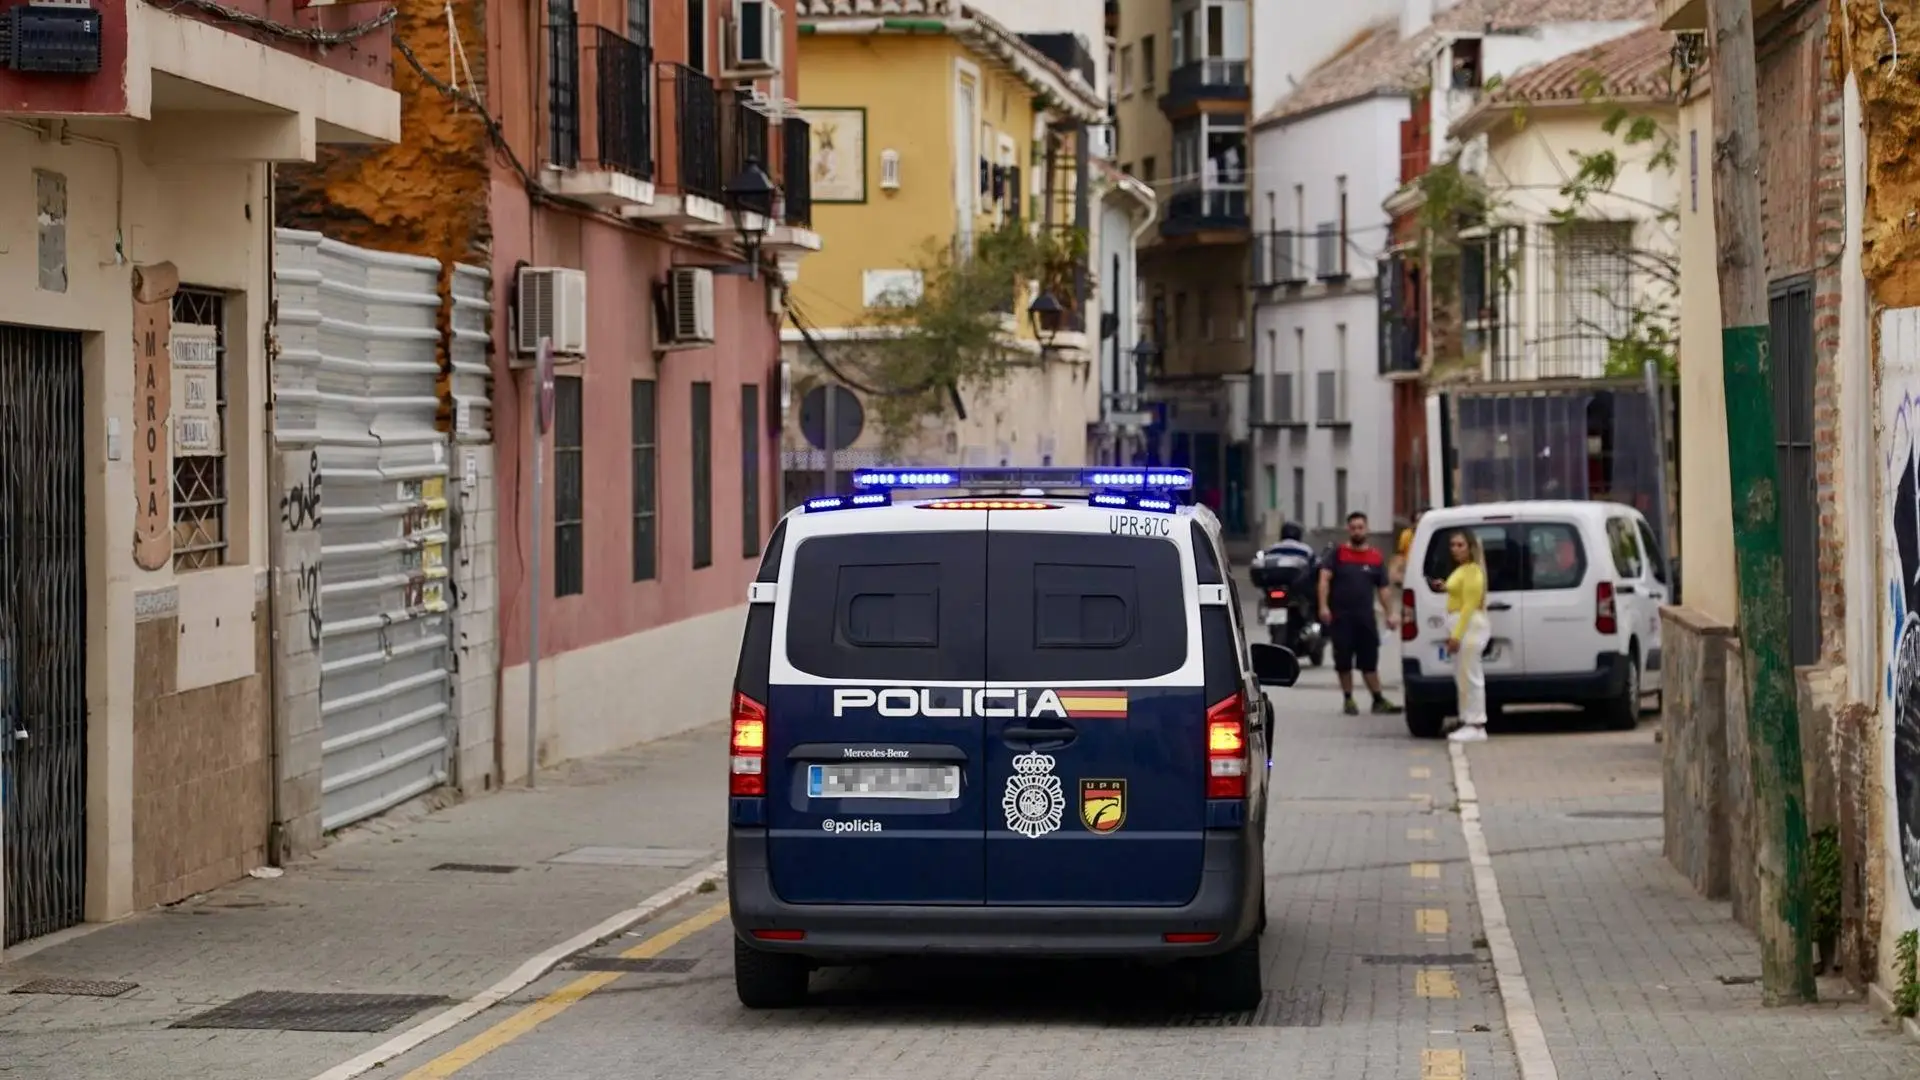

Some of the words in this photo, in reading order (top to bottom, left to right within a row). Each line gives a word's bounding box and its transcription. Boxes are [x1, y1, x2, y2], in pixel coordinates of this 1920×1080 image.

[145, 331, 158, 518] MAROLA
[1109, 515, 1170, 536] UPR-87C
[843, 748, 910, 759] Mercedes-Benz
[822, 818, 882, 834] @policia
